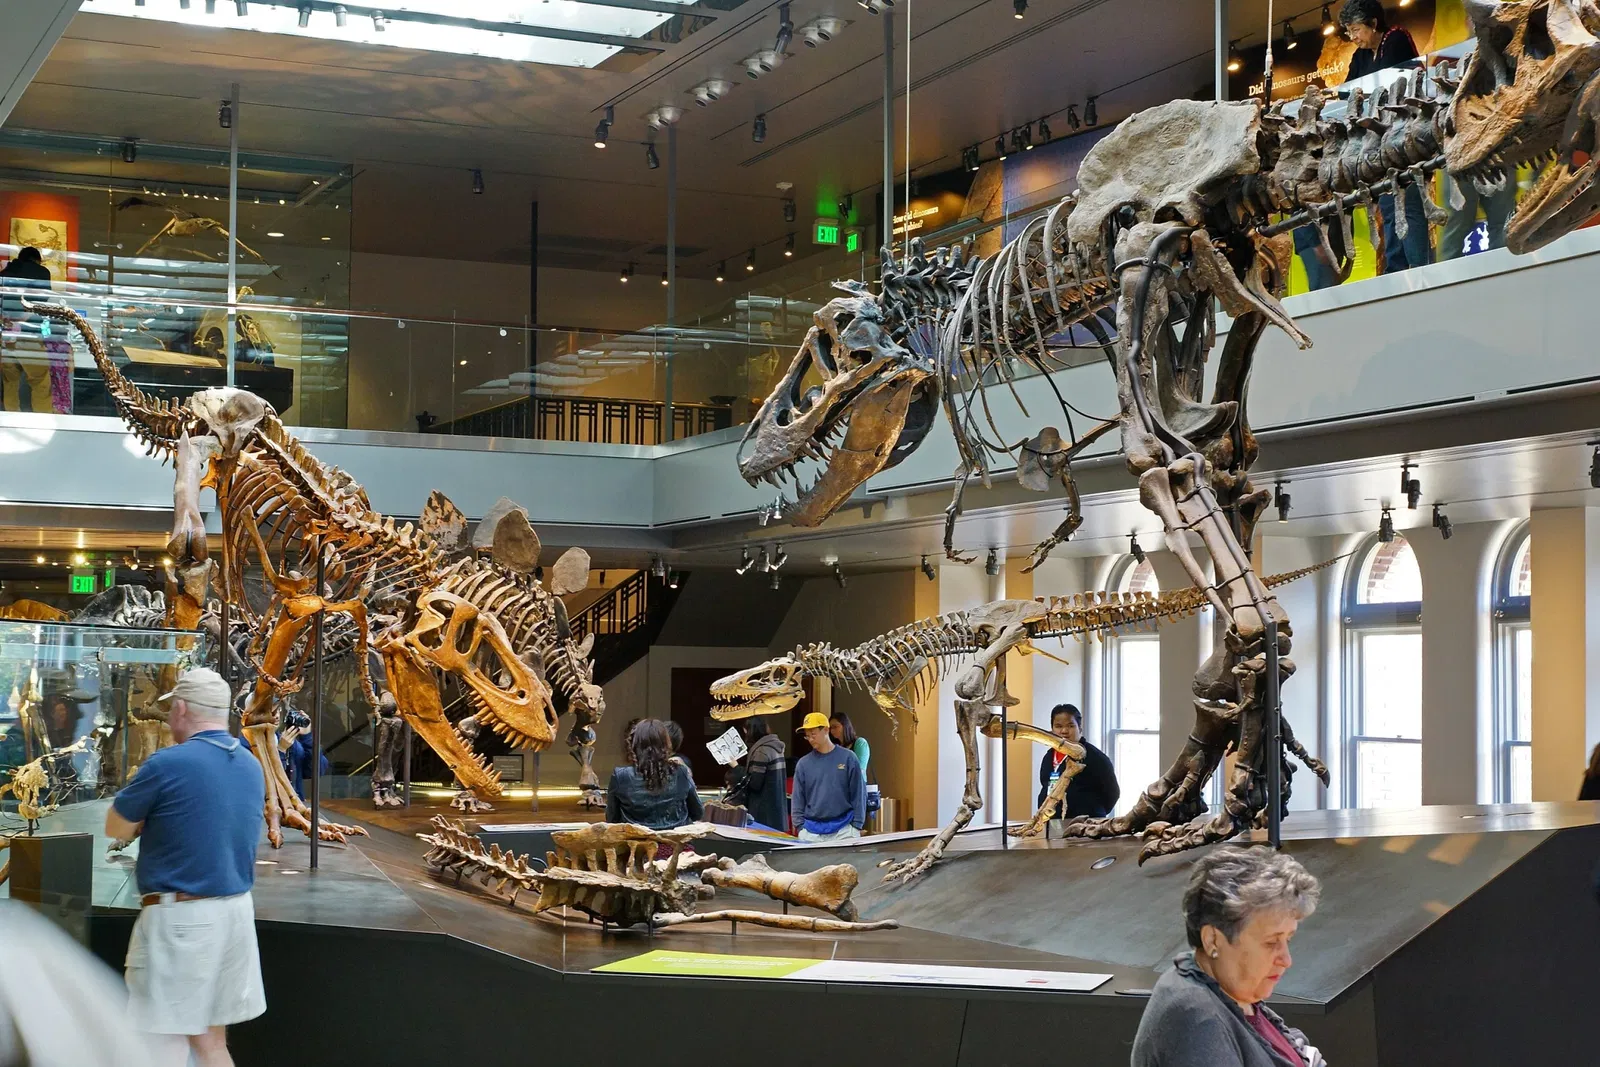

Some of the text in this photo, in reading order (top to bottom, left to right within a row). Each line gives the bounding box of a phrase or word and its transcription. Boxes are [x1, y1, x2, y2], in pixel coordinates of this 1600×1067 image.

[1248, 82, 1264, 97] Did
[1306, 72, 1321, 83] get
[1322, 61, 1345, 75] sick?
[817, 225, 838, 244] EXIT
[72, 575, 95, 593] EXIT
